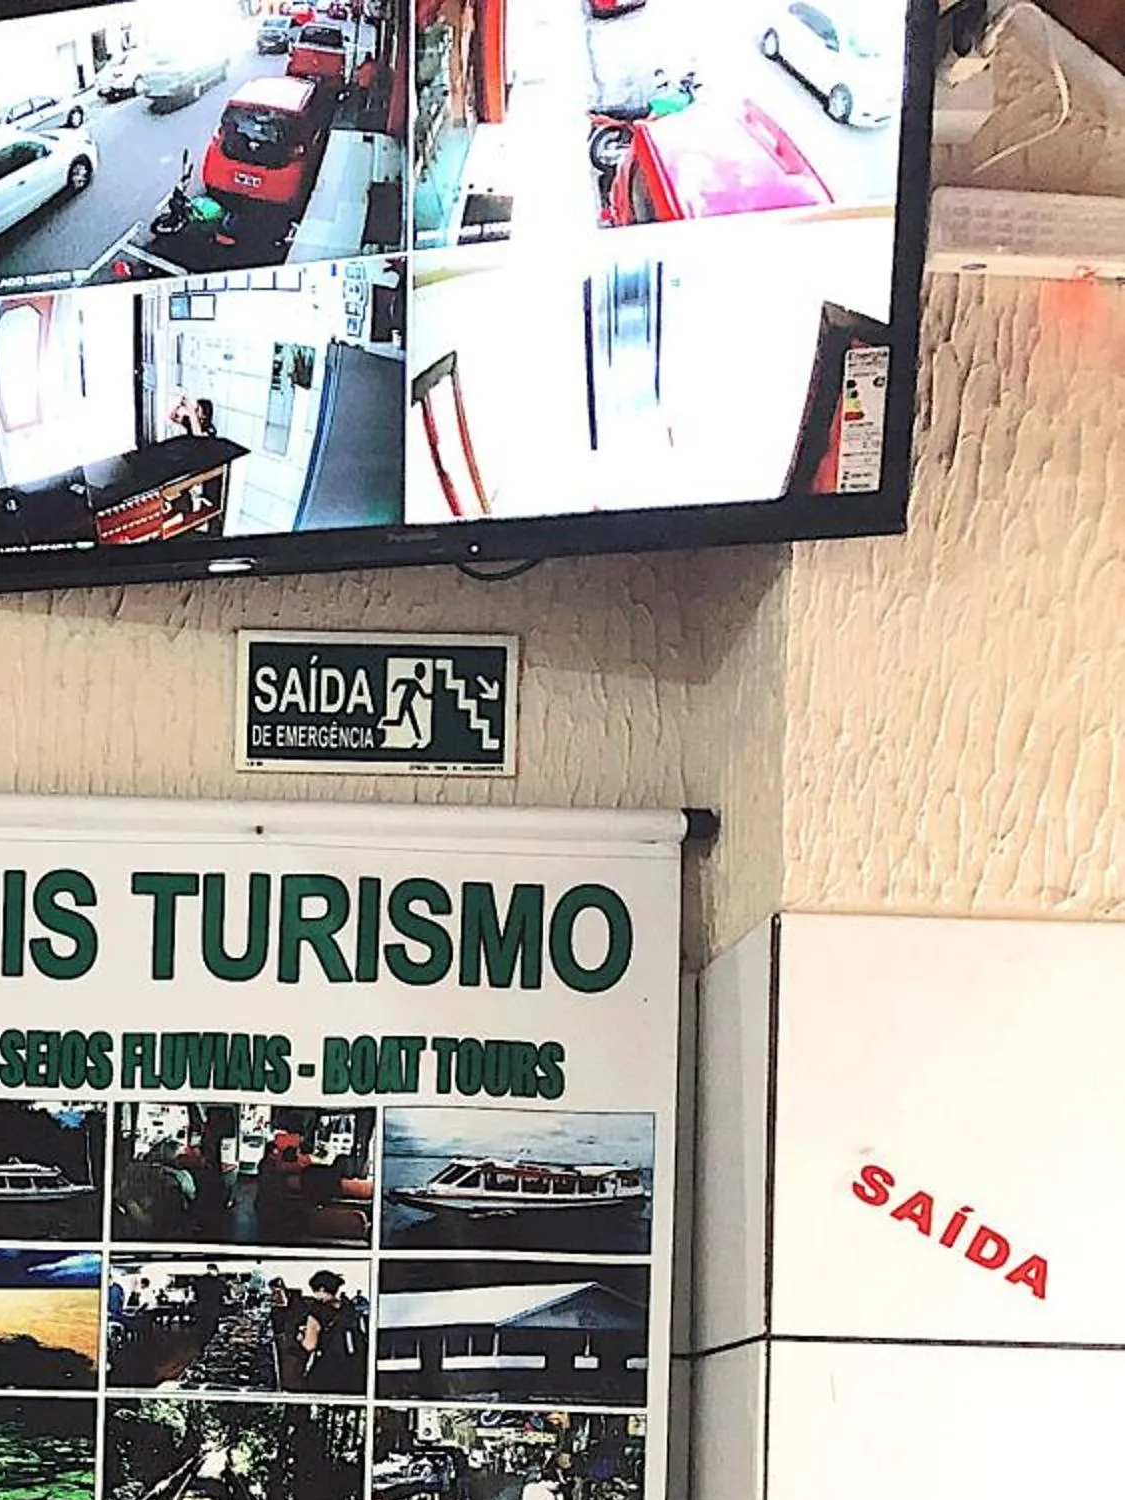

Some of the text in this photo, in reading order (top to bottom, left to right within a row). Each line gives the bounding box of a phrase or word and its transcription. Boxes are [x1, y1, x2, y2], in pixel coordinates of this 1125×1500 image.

[253, 655, 375, 714] SAÍDA
[252, 721, 374, 749] DE EMERGÊNCIA
[131, 871, 634, 994] TURISMO
[121, 1031, 292, 1095] FLUVIAIS
[322, 1034, 427, 1096] BOAT
[431, 1035, 566, 1101] TOURS
[852, 1164, 1048, 1300] SAÍDA
